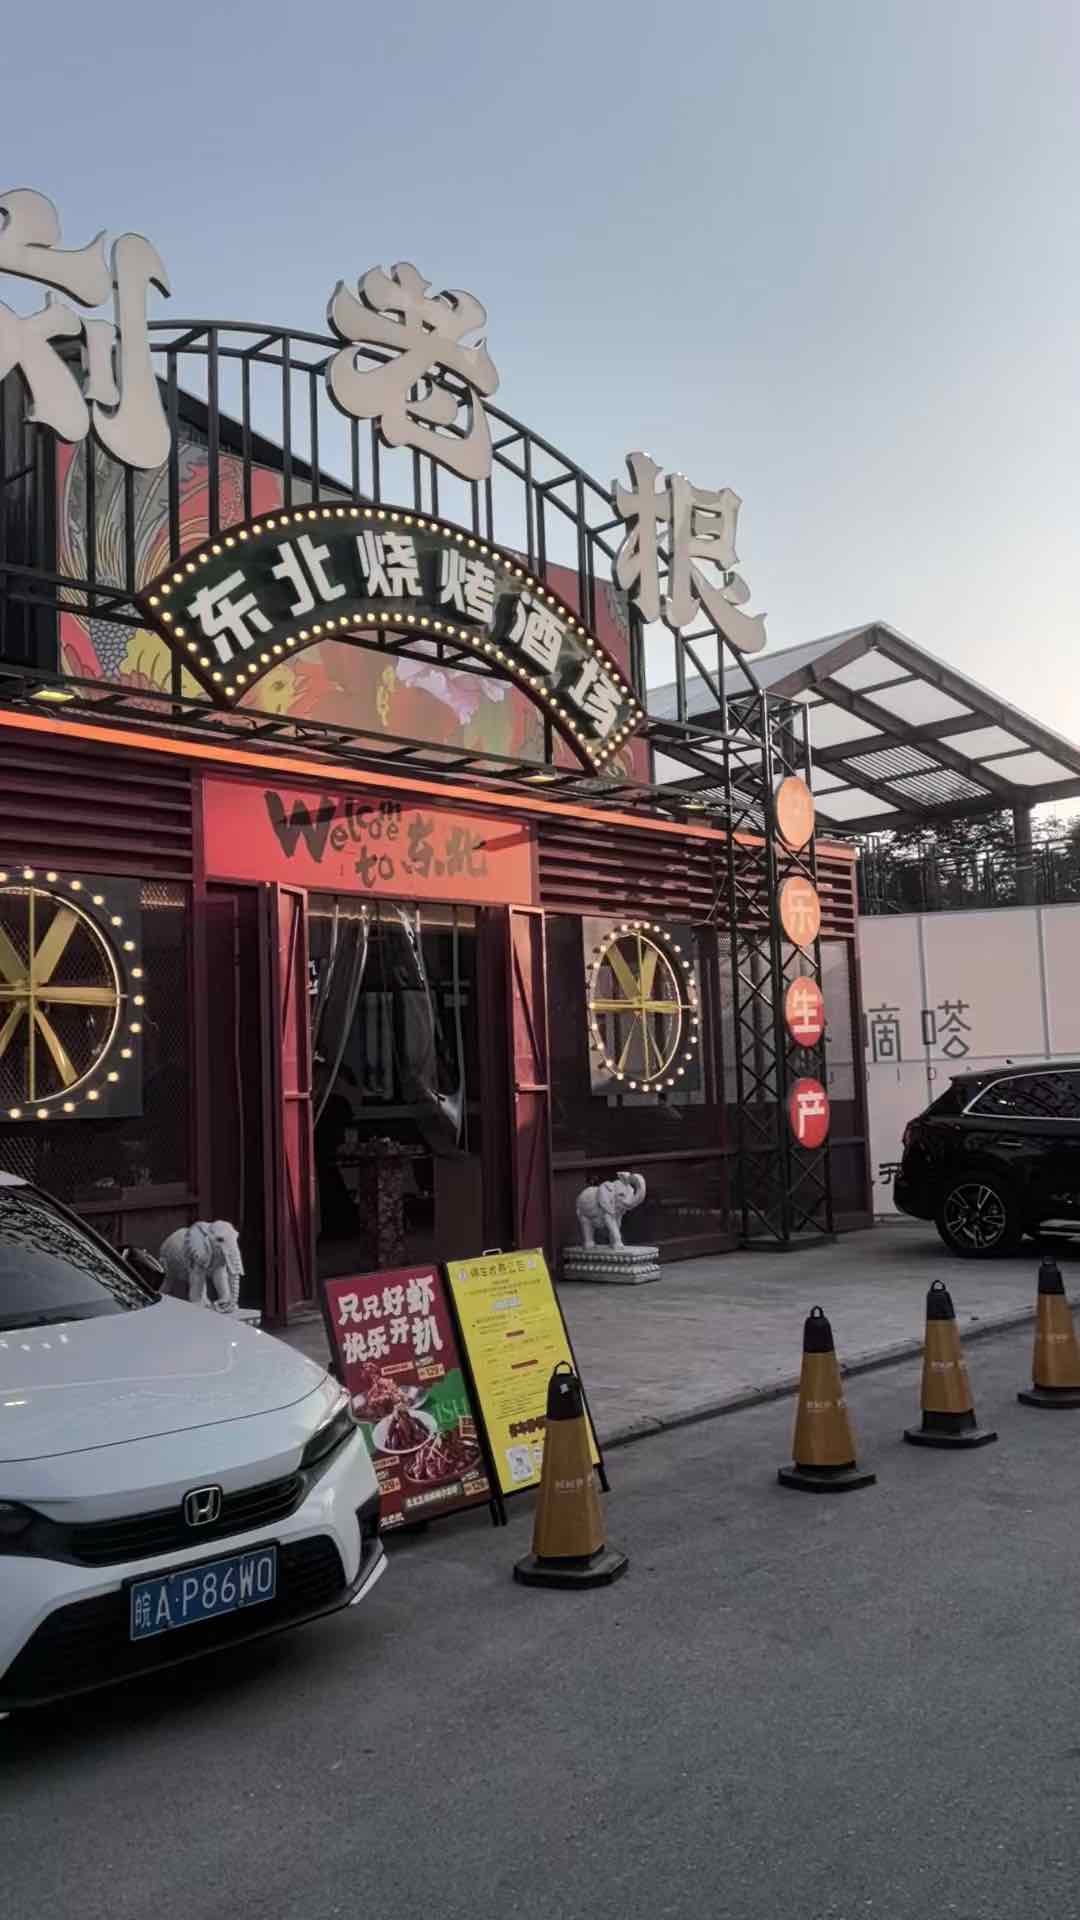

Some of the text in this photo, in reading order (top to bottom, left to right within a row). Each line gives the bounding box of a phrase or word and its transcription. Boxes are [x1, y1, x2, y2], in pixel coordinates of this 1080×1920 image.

[186, 529, 624, 739] 东北烧烤酒场
[355, 846, 395, 888] to
[338, 1275, 435, 1326] 只只好虾
